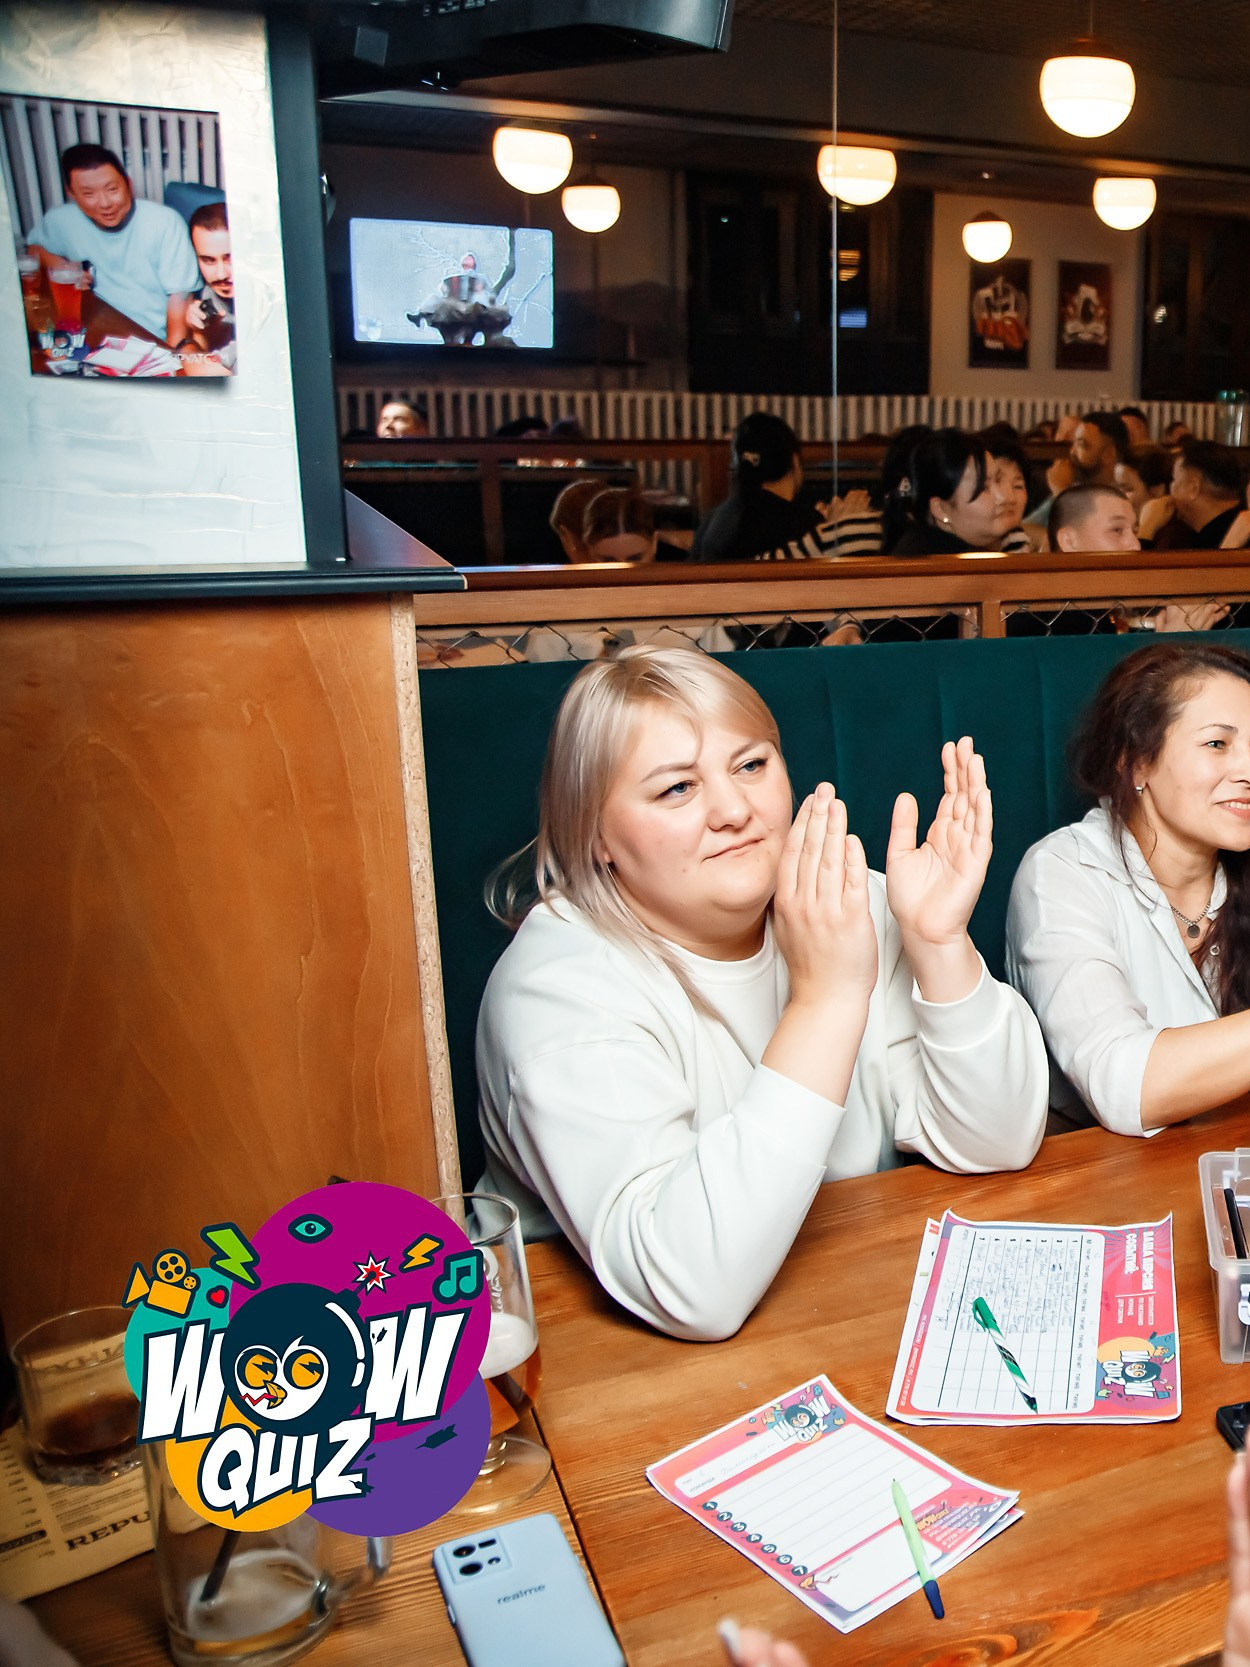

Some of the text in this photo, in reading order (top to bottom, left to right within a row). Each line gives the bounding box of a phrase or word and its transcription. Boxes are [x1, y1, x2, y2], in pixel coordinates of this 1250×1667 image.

[1102, 1361, 1127, 1386] QUIZ
[1121, 1350, 1161, 1398] WOW
[773, 1395, 831, 1441] WOW
[797, 1416, 828, 1442] QUIZ
[497, 1584, 546, 1604] realme
